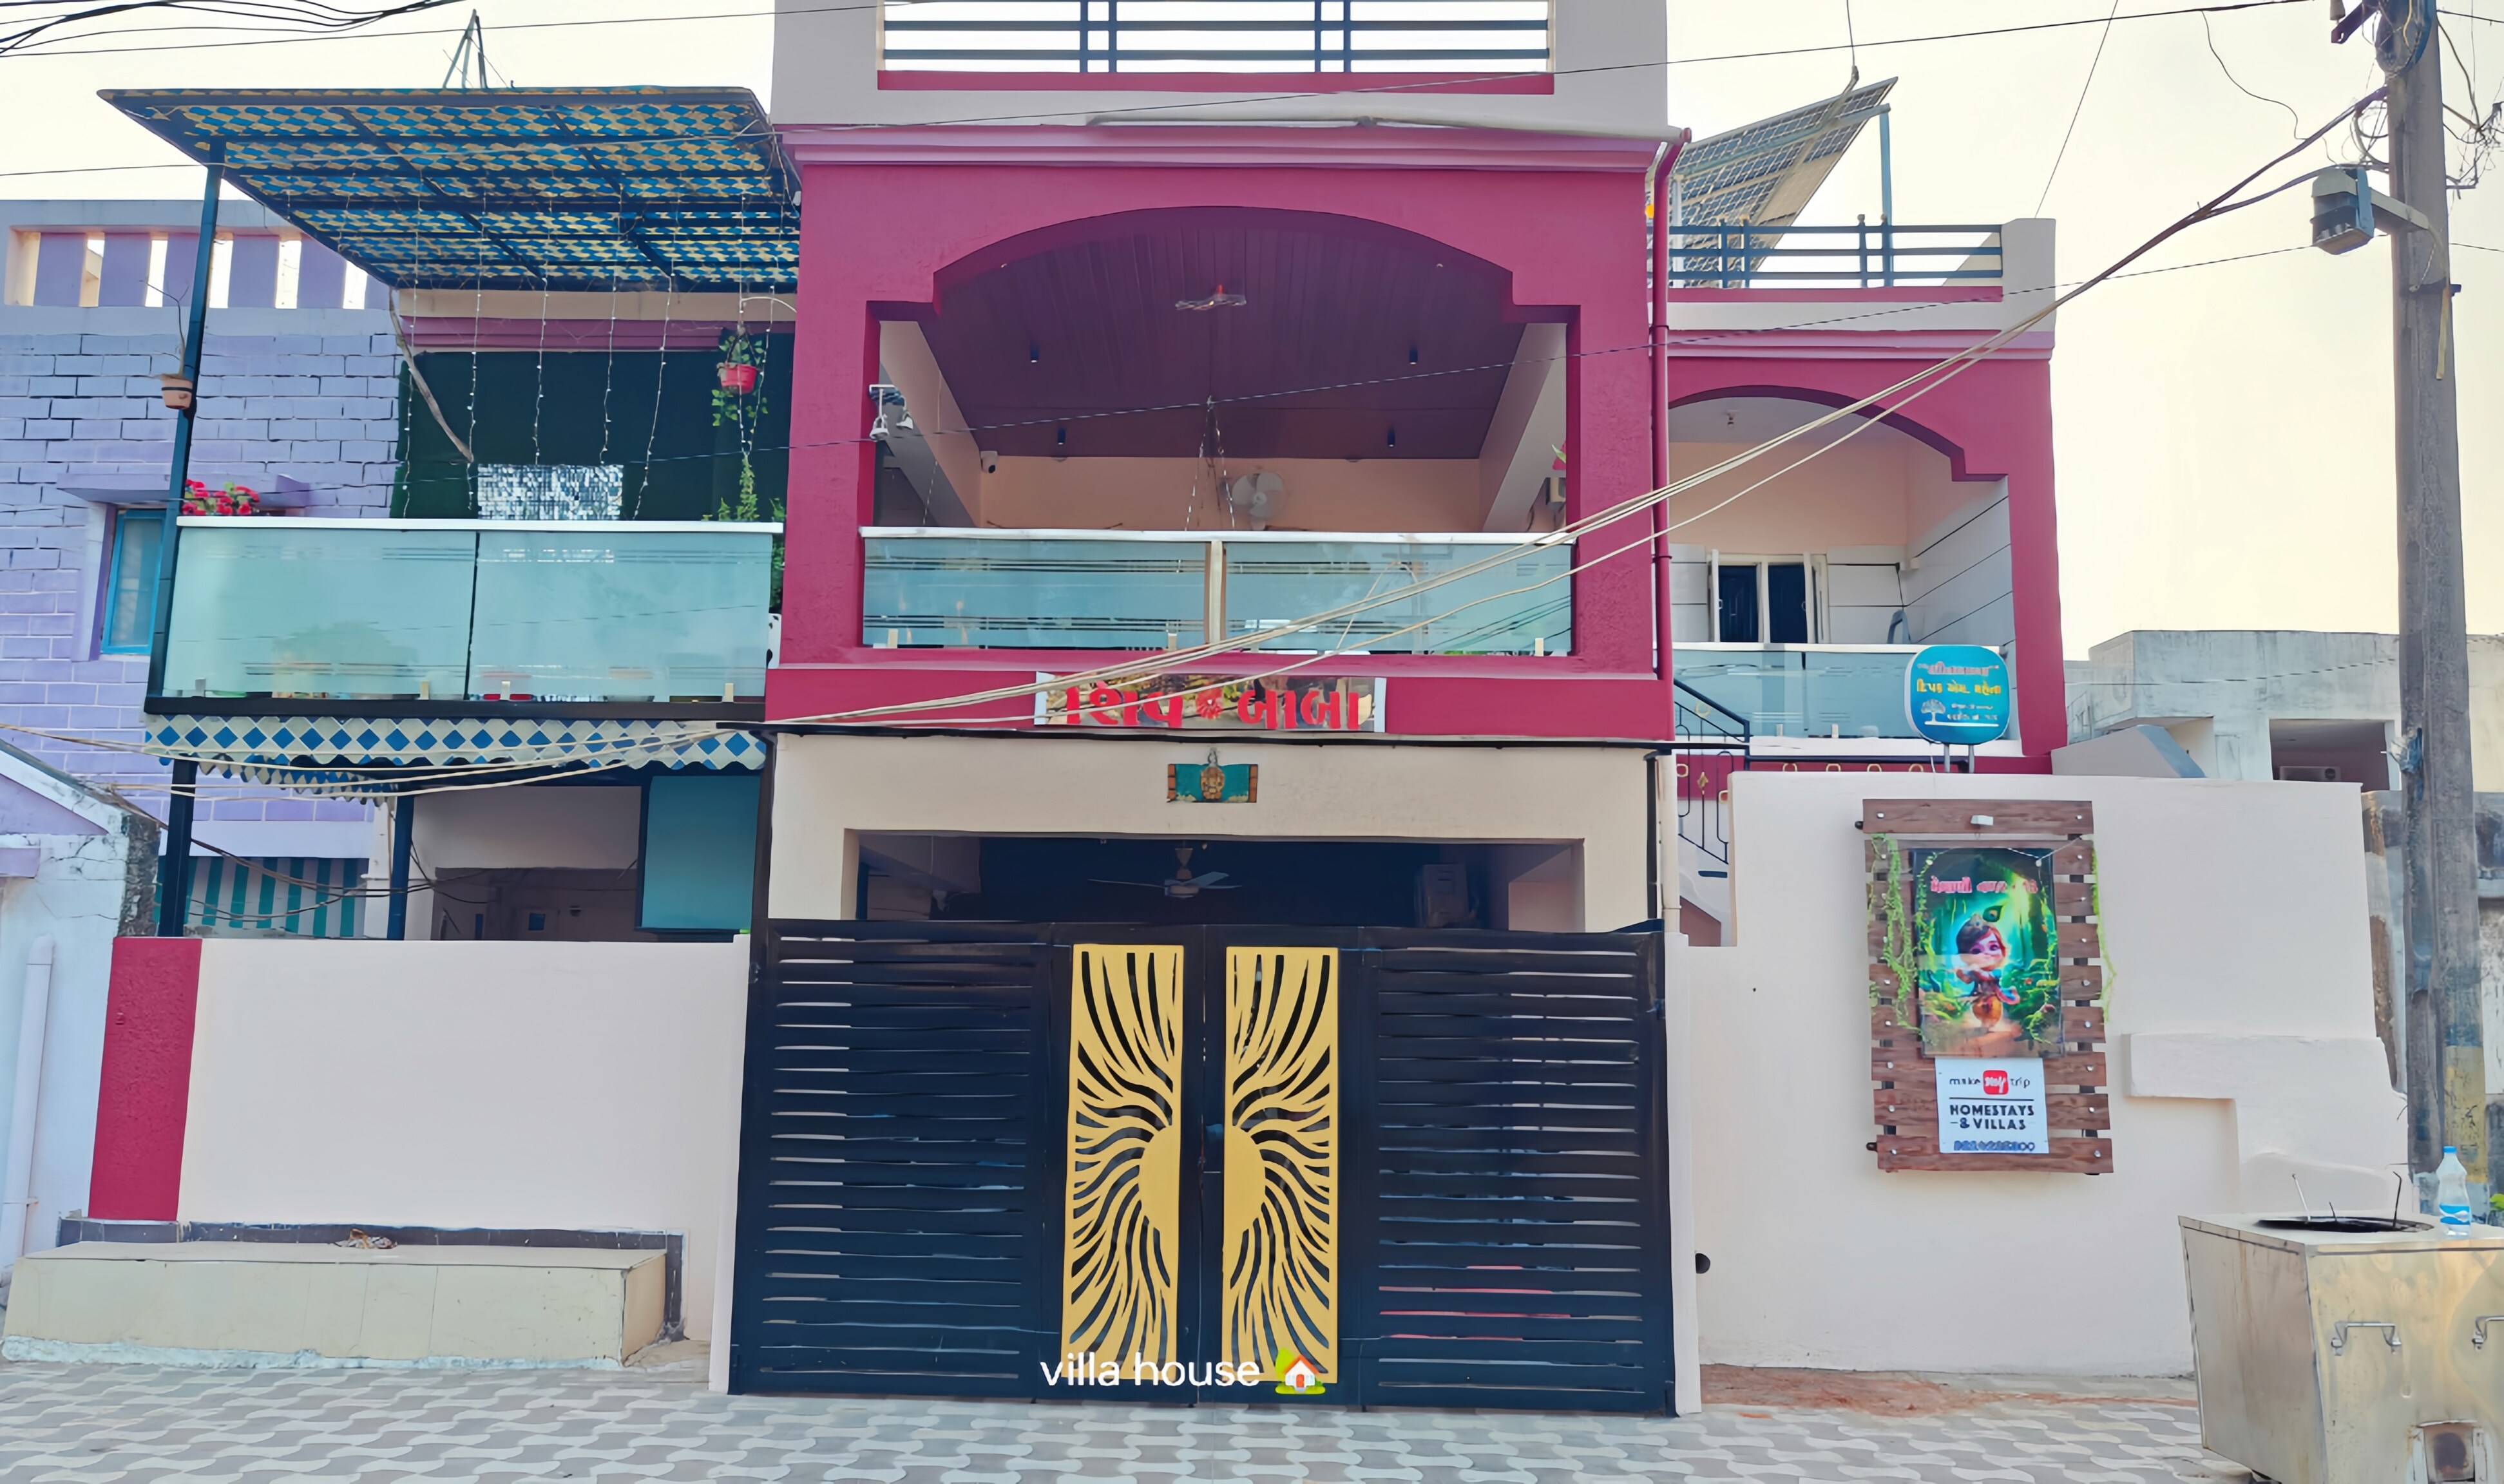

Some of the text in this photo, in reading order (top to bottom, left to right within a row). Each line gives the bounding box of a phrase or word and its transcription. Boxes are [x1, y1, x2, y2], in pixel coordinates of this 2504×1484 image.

[1066, 681, 1360, 729] શિવ બાબા
[2010, 1076, 2031, 1089] trip
[1949, 1104, 2035, 1116] HOMESTAYS
[1959, 1117, 2027, 1130] & VILLAS
